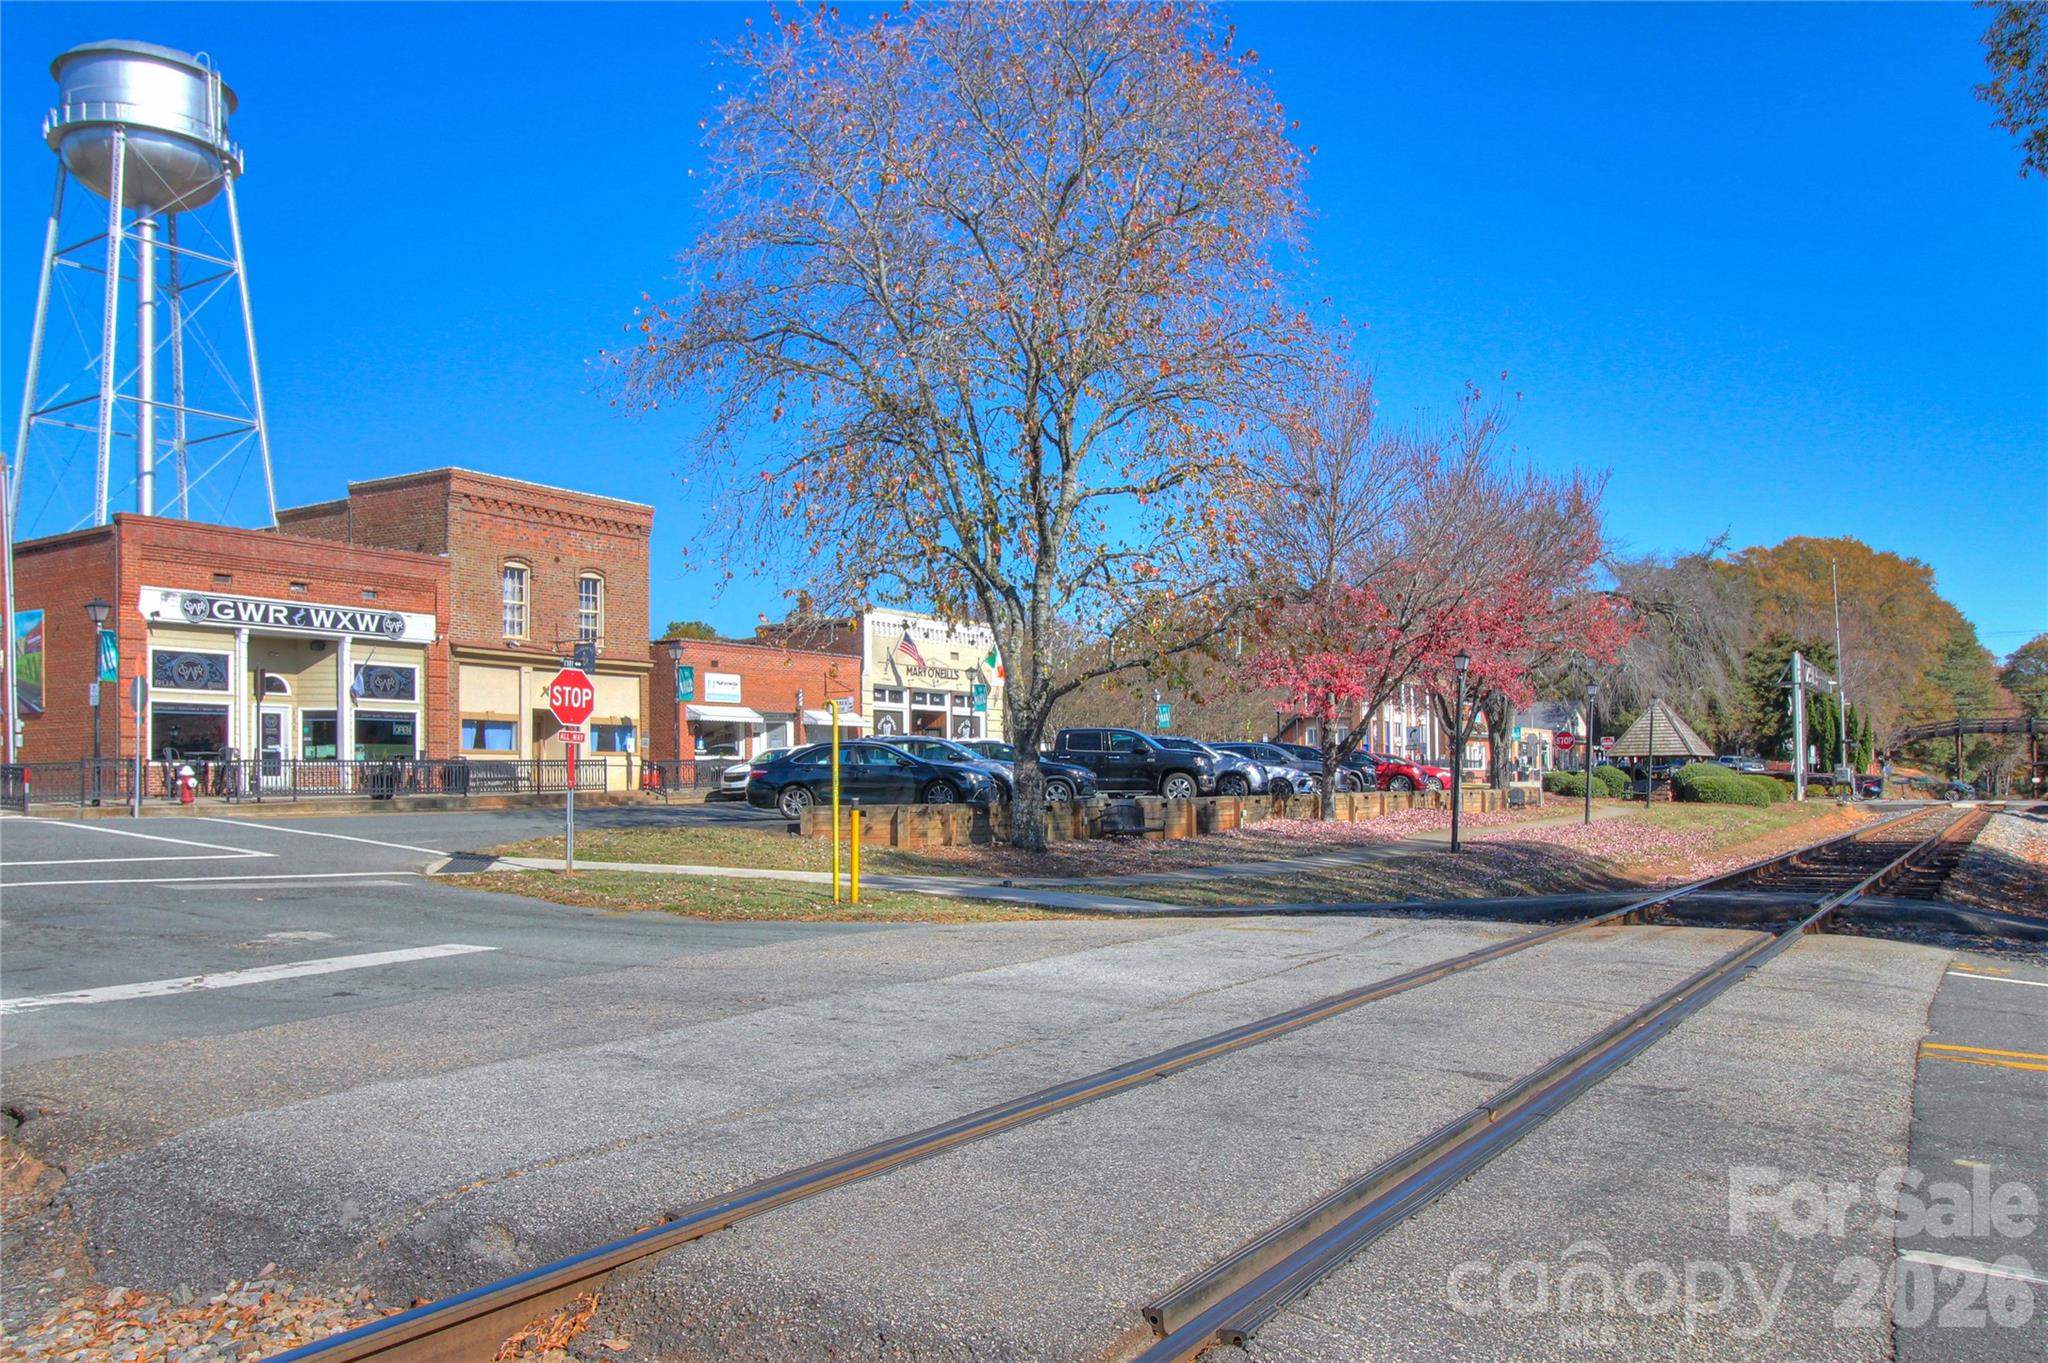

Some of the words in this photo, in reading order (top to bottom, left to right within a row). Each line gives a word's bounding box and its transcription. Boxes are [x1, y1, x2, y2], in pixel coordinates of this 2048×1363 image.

[212, 600, 289, 625] GWR
[309, 608, 380, 632] WXW
[906, 665, 927, 677] MARY
[928, 667, 960, 681] O'NEILL'S
[552, 685, 592, 709] STOP
[560, 733, 570, 741] ALL
[572, 734, 584, 742] WAY
[1556, 736, 1573, 745] STOP
